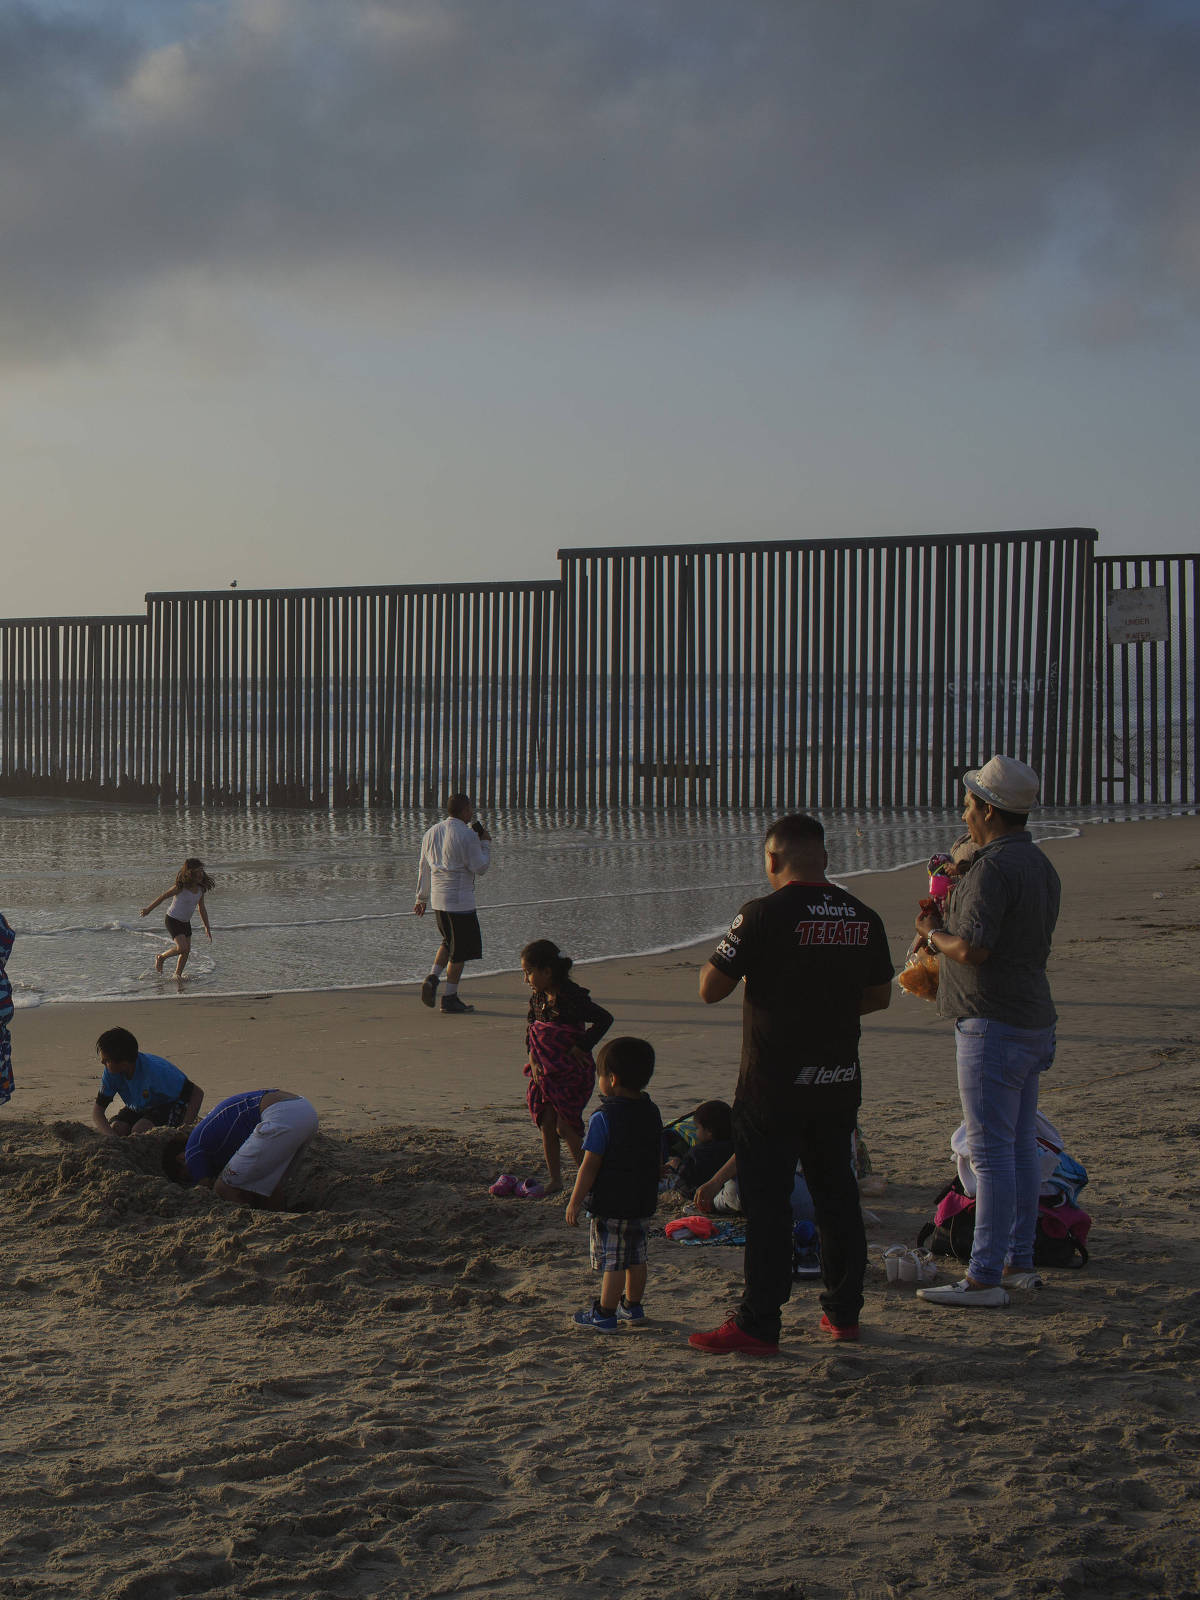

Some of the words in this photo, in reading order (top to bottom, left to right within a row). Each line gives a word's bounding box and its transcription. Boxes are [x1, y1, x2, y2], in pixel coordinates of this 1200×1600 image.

[807, 901, 856, 917] volaris
[795, 919, 869, 945] TECATE
[815, 1062, 856, 1084] telcel
